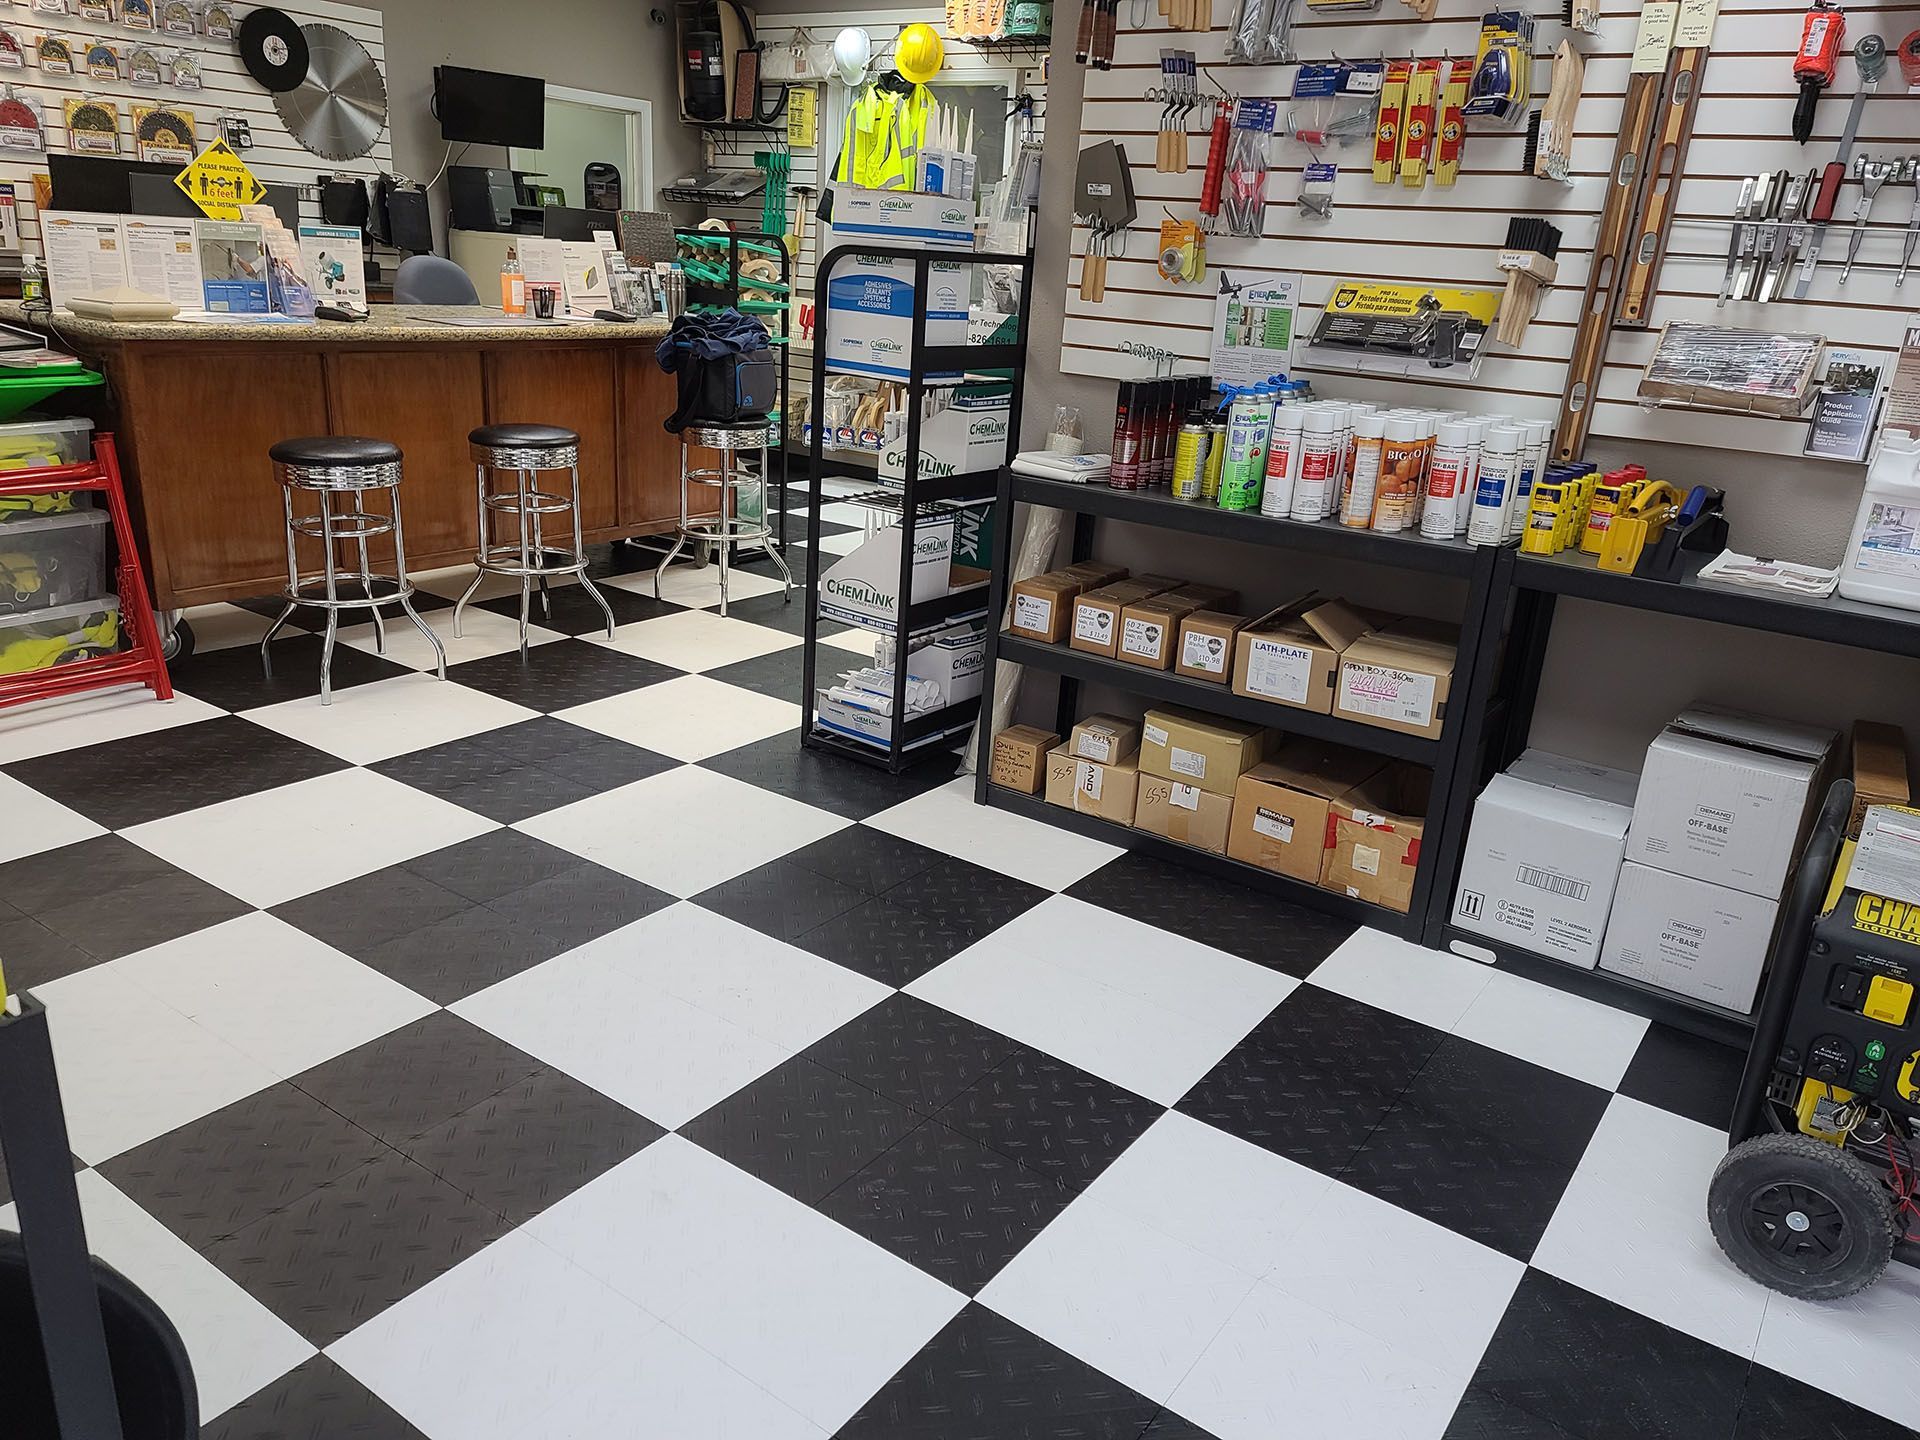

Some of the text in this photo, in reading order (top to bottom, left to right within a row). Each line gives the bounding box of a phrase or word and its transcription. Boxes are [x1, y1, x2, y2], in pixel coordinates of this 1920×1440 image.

[219, 165, 245, 173] PRACTICE
[209, 188, 234, 198] 6 feet
[217, 201, 240, 209] DISTANC
[864, 280, 892, 290] ADHESIVES
[865, 287, 892, 296] SEALANTS
[863, 294, 887, 303] SYSTEMS
[1358, 294, 1382, 304] Pistolet
[1388, 298, 1413, 306] mousse
[857, 299, 891, 310] ACCESSORIES
[1354, 302, 1373, 311] Pistola
[1373, 304, 1388, 313] para
[980, 319, 1017, 332] Technolog
[1824, 401, 1852, 411] Product
[1821, 408, 1862, 419] Application
[1820, 416, 1842, 424] Guide
[867, 603, 894, 614] INNOVATION
[1188, 633, 1205, 643] PBH
[1186, 640, 1206, 648] Washer
[1255, 641, 1309, 660] LATH-PLATE
[1343, 661, 1365, 672] OPEN
[1349, 673, 1403, 691] LATH LOCK
[1259, 808, 1292, 823] DEMAND
[1699, 807, 1731, 819] DEMAND
[1688, 818, 1729, 834] OFF-BASE
[1550, 917, 1564, 926] LEVEL
[1672, 922, 1704, 934] DEMAND
[1856, 922, 1903, 938] GLOBAL
[1661, 932, 1700, 949] OFF-BASE
[1869, 1050, 1880, 1058] LPG
